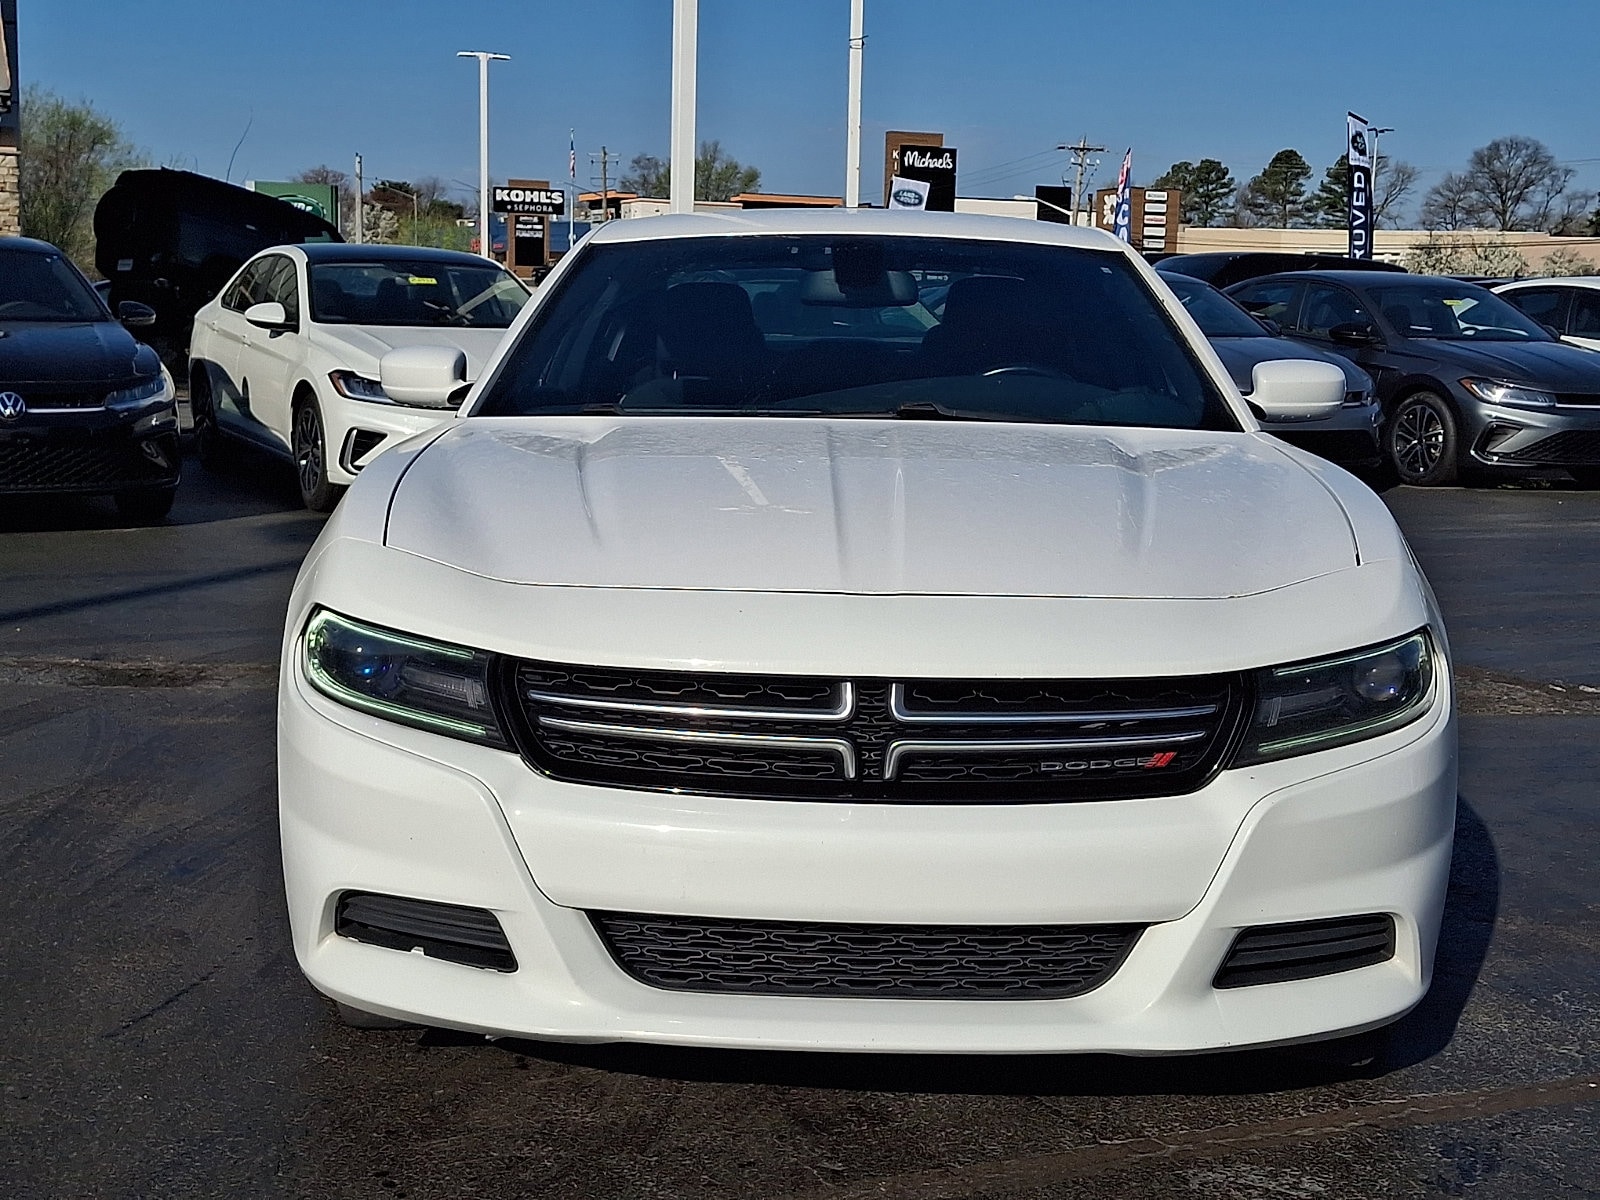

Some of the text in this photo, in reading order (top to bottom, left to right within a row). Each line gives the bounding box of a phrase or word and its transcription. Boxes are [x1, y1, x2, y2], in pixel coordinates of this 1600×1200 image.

[903, 150, 953, 169] Michaels
[495, 188, 564, 204] KOHL'S
[513, 203, 554, 212] SEPHORA
[1040, 757, 1157, 771] DODGE
